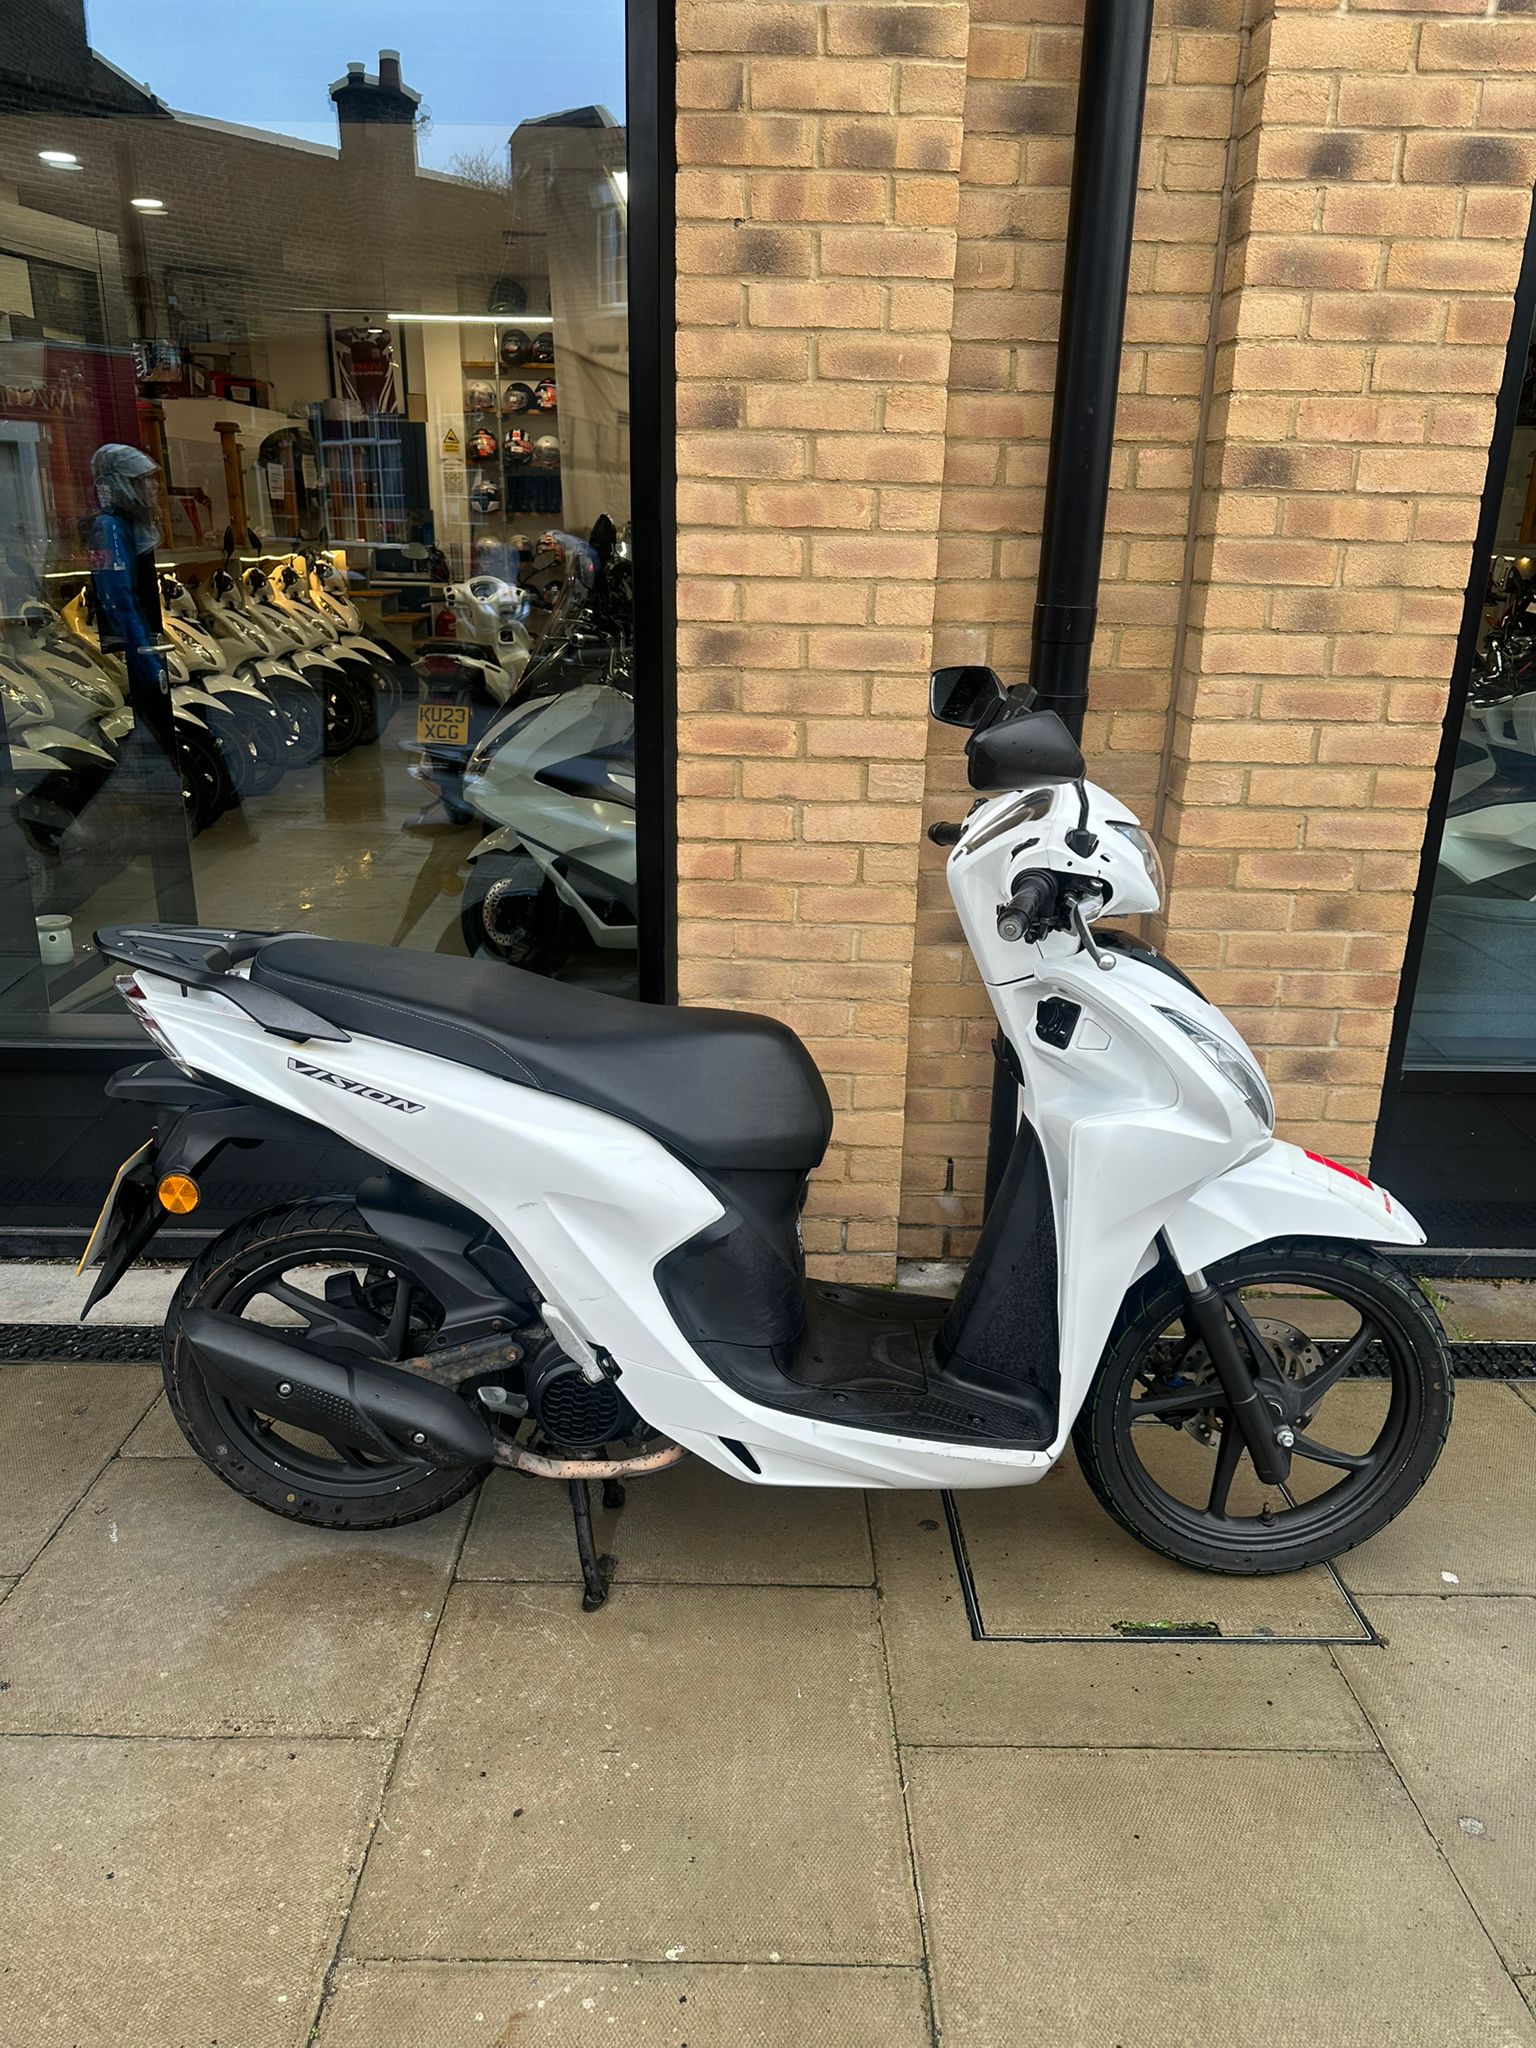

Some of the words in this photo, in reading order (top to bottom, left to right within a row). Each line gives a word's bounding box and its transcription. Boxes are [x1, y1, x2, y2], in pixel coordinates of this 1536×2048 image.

[420, 707, 465, 723] KU23
[424, 723, 459, 739] XCG
[288, 1057, 425, 1114] VISION
